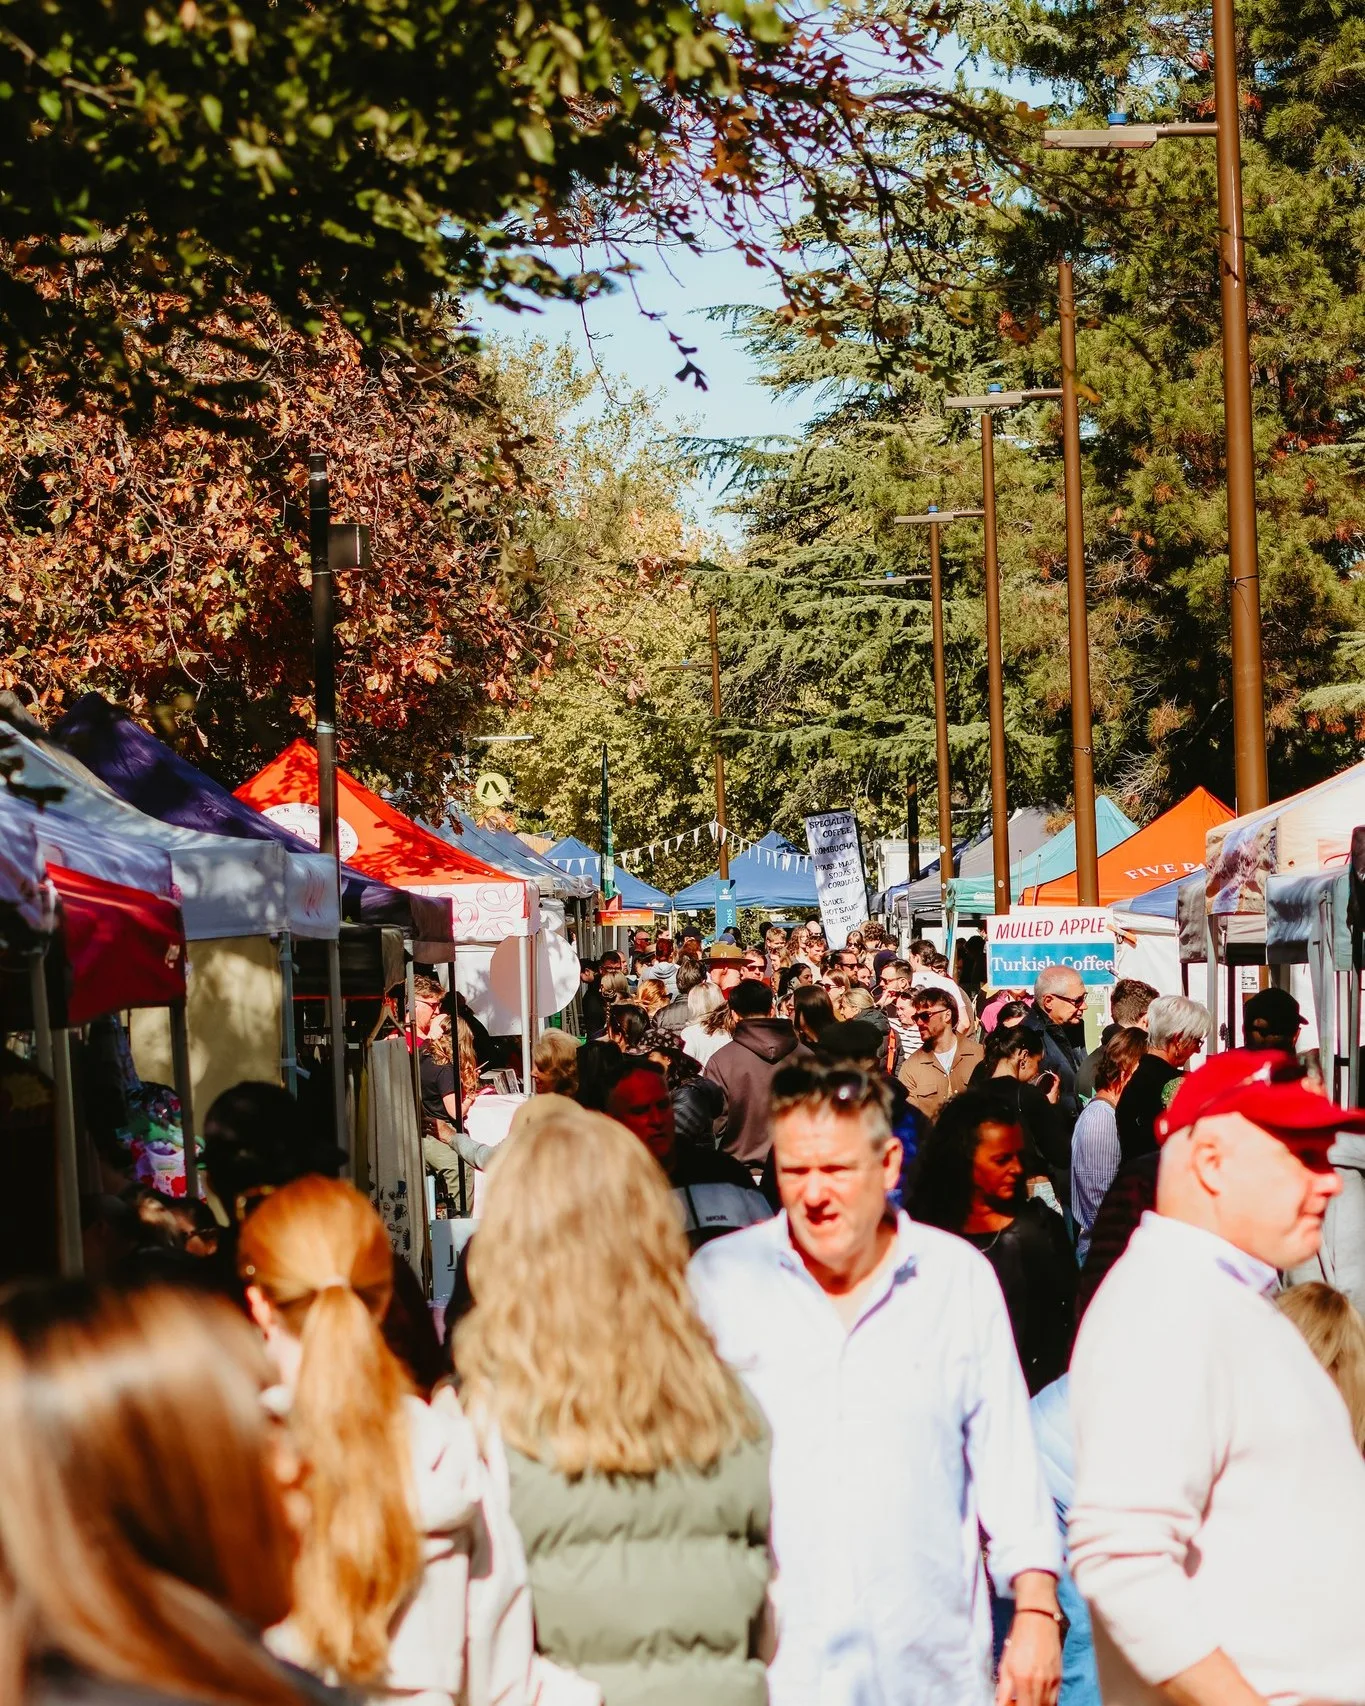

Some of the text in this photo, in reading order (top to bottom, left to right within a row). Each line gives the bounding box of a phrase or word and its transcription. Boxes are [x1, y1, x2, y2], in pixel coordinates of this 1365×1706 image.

[809, 816, 852, 829] SPECIALTY
[822, 826, 853, 838] COFFEE
[814, 842, 855, 855] KOMBUCHA
[1124, 863, 1178, 880] FIVE
[995, 917, 1106, 940] MULLED APPLE
[991, 955, 1115, 972] Turkish Coffee
